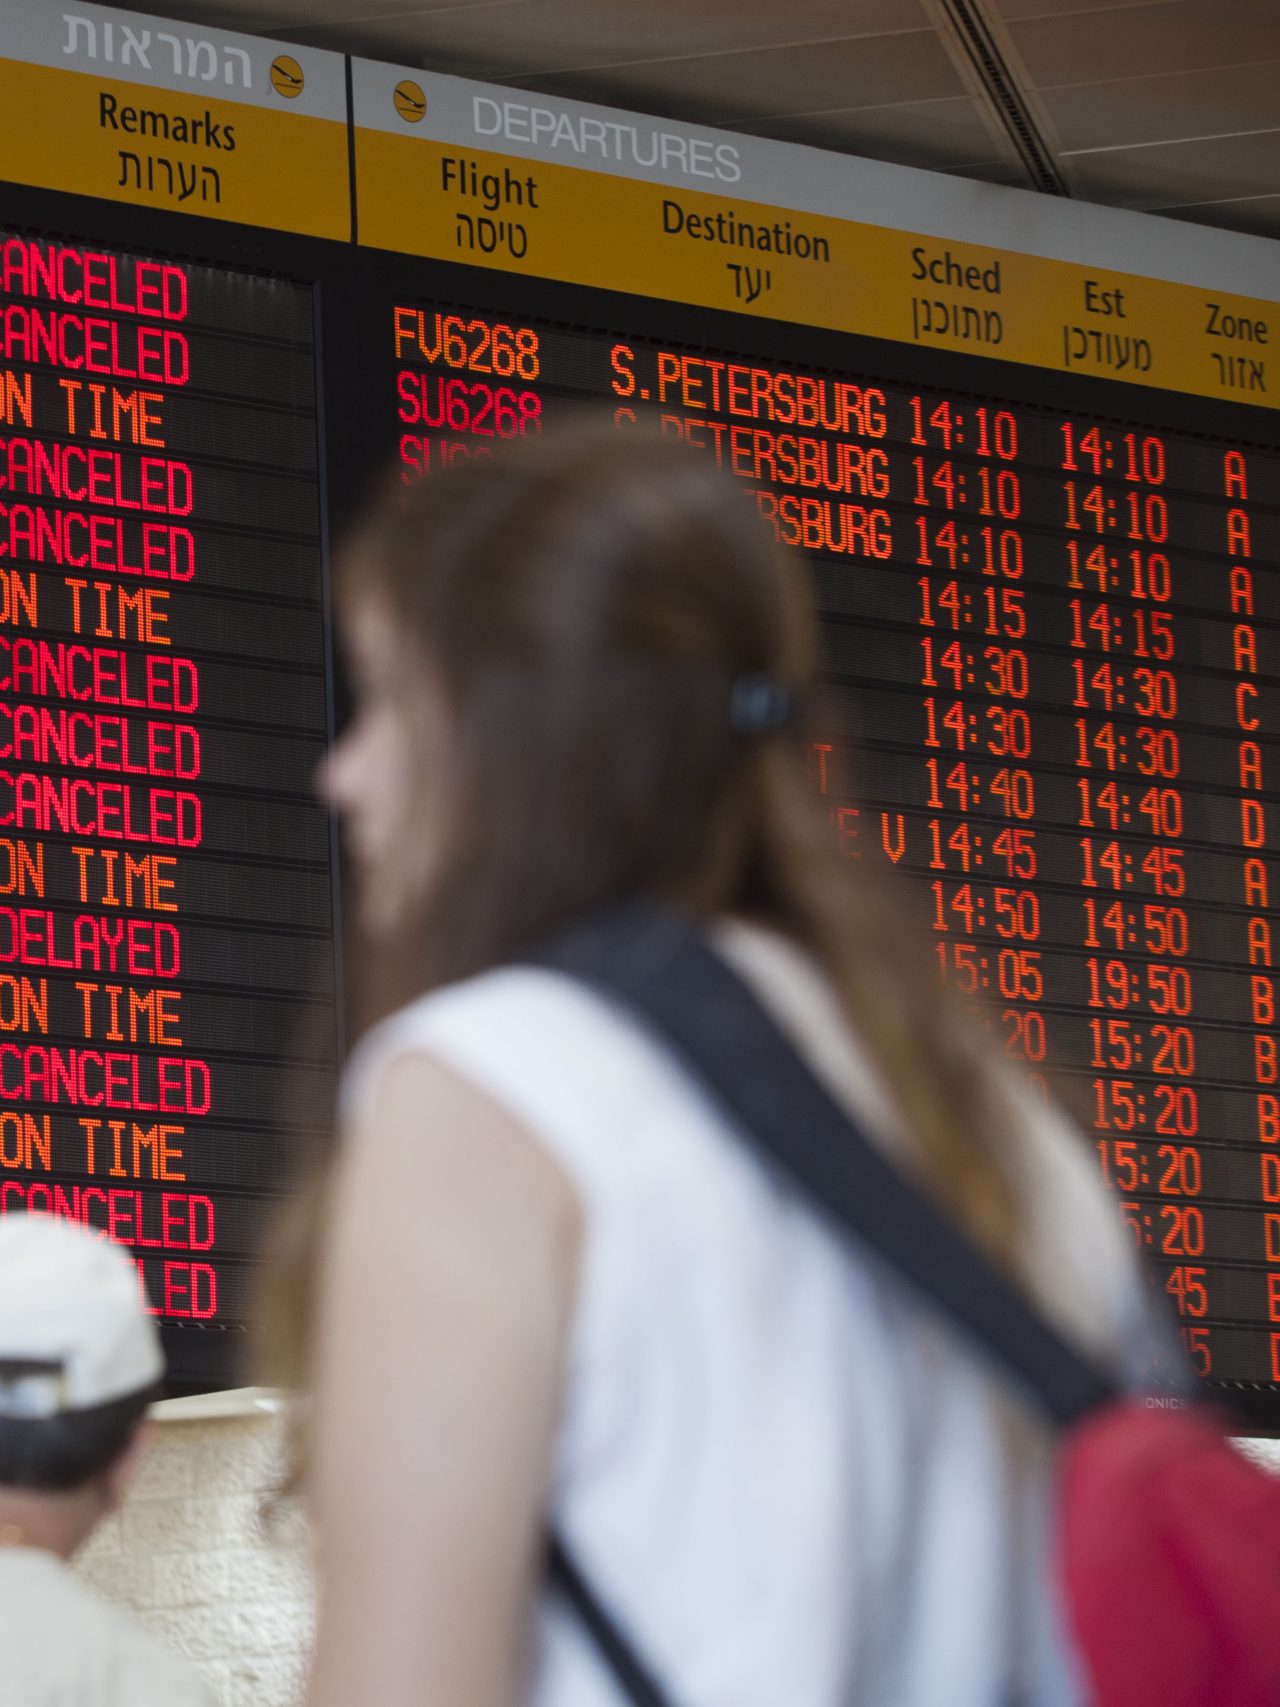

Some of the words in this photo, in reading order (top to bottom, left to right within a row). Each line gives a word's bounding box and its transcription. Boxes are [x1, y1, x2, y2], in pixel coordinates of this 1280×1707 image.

[63, 14, 251, 88] המראות
[100, 92, 235, 151] Remarks
[473, 96, 741, 182] DEPARTURES
[118, 151, 220, 203] הערות
[441, 157, 539, 211] Flight
[456, 213, 528, 258] טיסה
[663, 200, 830, 263] Destination
[726, 263, 771, 304] יעד
[912, 247, 1001, 294] Sched
[1084, 280, 1126, 318] Est
[913, 297, 1003, 344] מתוכנן
[1063, 325, 1152, 372] מעודכן
[1205, 303, 1269, 344] Zone
[393, 305, 541, 381] FV6268
[908, 395, 1018, 461] 14:10
[1060, 422, 1166, 485] 14:10
[1223, 450, 1248, 500] A
[1211, 353, 1266, 392] אזור
[59, 379, 166, 448] TIME
[397, 370, 542, 440] SU6268
[912, 455, 1021, 520] 14:10
[1062, 480, 1168, 543] 14:10
[1226, 508, 1251, 558] A
[914, 515, 1024, 579] 14:10
[1066, 539, 1172, 602] 14:10
[1229, 566, 1255, 616] A
[65, 577, 172, 645] TIME
[917, 576, 1027, 639] 14:15
[1068, 598, 1175, 661] 14:15
[1232, 624, 1257, 673] A
[920, 636, 1030, 699] 14:30
[1072, 658, 1178, 720] 14:30
[1235, 681, 1260, 732] C
[923, 697, 1032, 760] 14:30
[1074, 718, 1181, 779] 14:30
[1238, 740, 1263, 791] A
[925, 758, 1035, 820] 14:40
[1076, 777, 1183, 838] 14:40
[1240, 798, 1265, 849] D
[71, 846, 179, 912] TIME
[928, 818, 1038, 880] 14:45
[1079, 837, 1186, 897] 14:45
[1244, 857, 1269, 908] A
[930, 879, 1040, 941] 14:50
[1083, 897, 1189, 957] 14:50
[1247, 916, 1272, 967] A
[74, 980, 183, 1047] TIME
[1086, 957, 1193, 1017] 19:50
[1250, 975, 1276, 1025] B
[1088, 1017, 1196, 1077] 15:20
[1254, 1033, 1278, 1085] B
[1092, 1078, 1199, 1137] 15:20
[77, 1117, 187, 1182] TIME
[1096, 1138, 1202, 1197] 15:20
